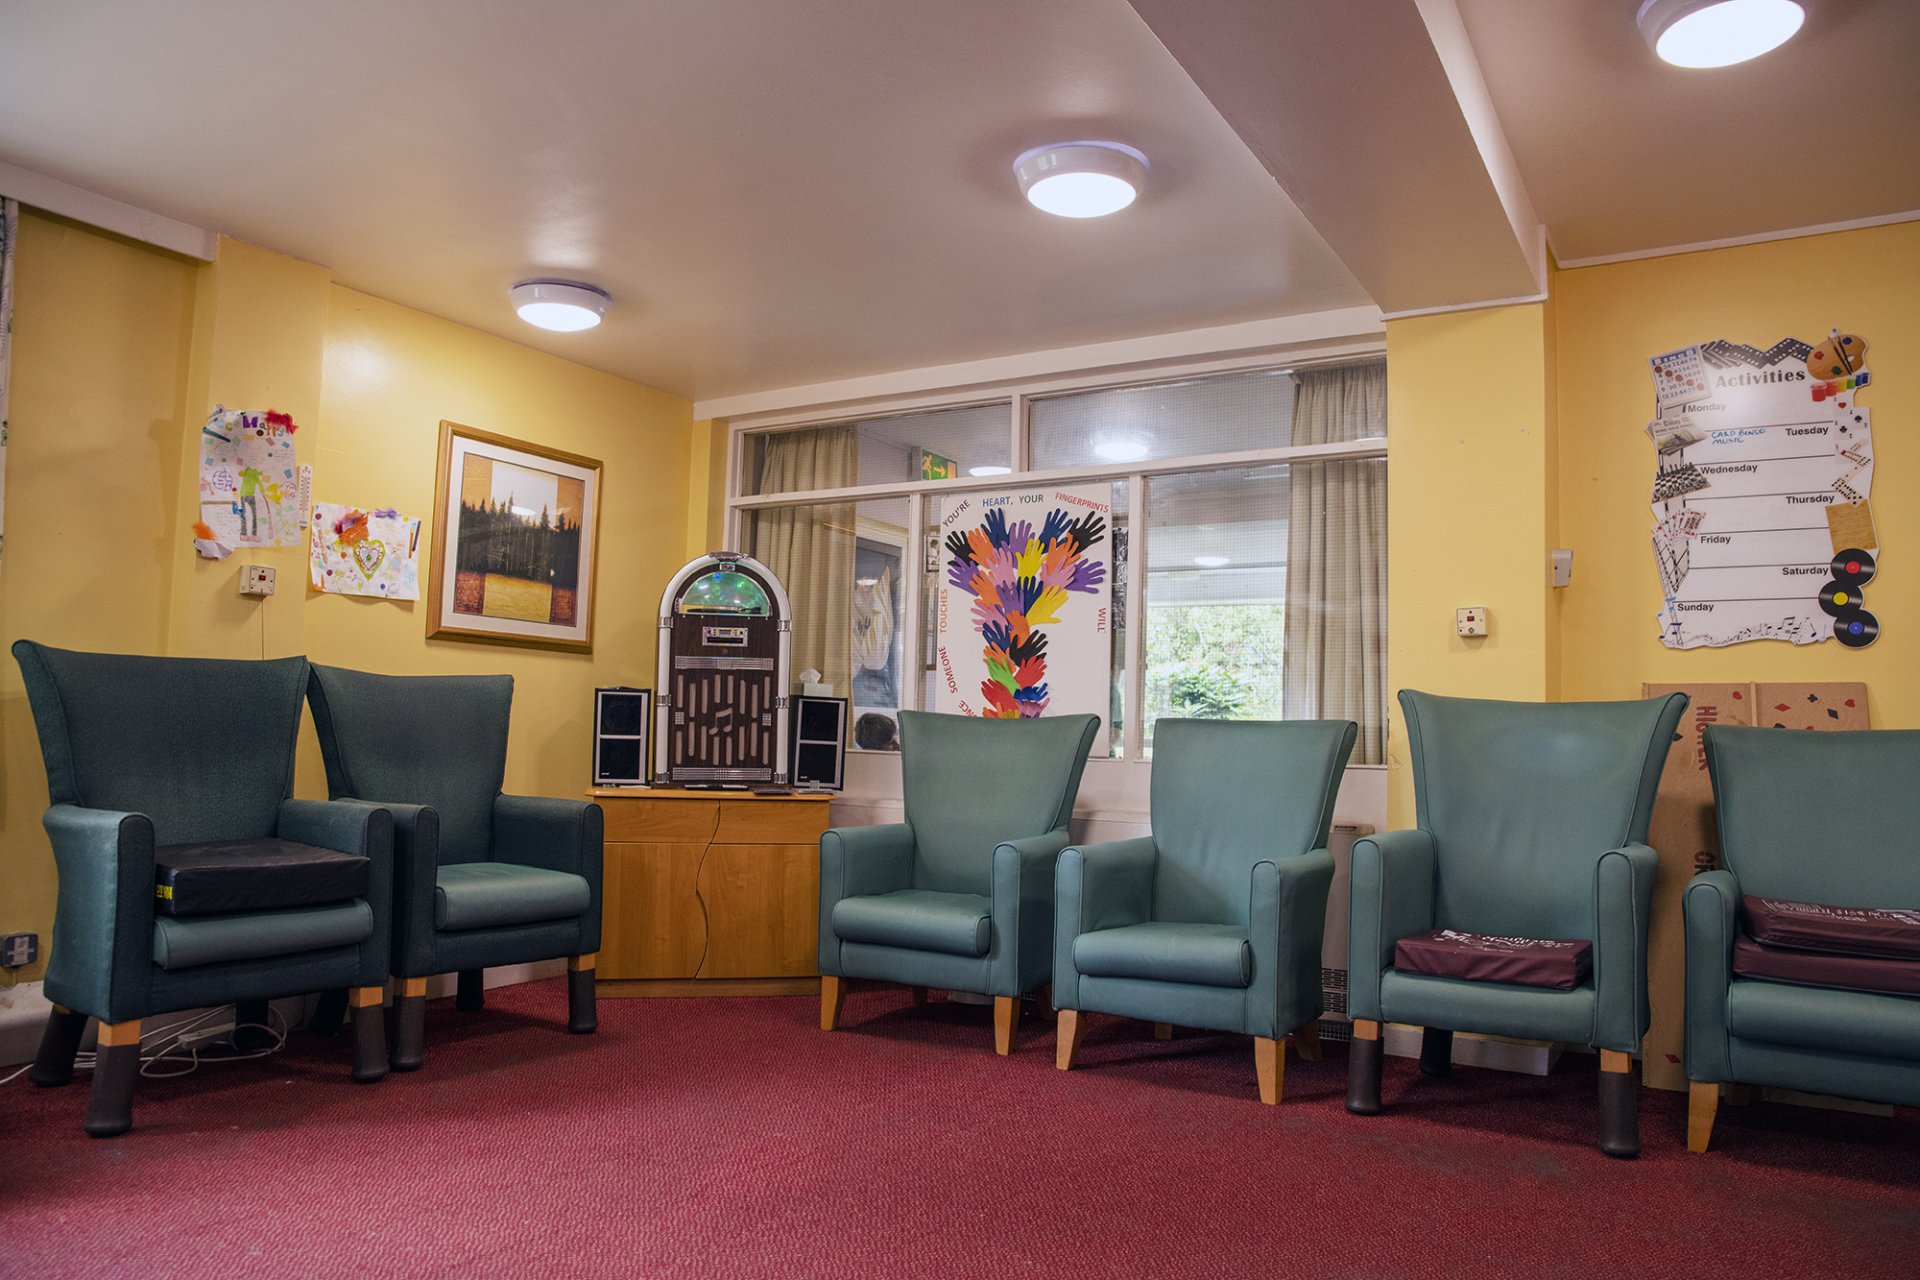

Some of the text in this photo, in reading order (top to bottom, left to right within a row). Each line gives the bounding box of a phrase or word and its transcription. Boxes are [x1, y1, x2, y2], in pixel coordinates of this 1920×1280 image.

[1716, 369, 1806, 388] Activities
[1687, 402, 1726, 412] Monday
[1785, 426, 1829, 436] Tuesday
[1712, 436, 1744, 445] MUSIC
[1700, 464, 1758, 474] Wednesday
[982, 495, 1013, 507] HEART,
[1018, 494, 1044, 504] YOUR
[1055, 492, 1110, 514] FINGERPRINTS
[1785, 494, 1835, 504] Thursday
[942, 499, 970, 528] YOU'RE
[1700, 535, 1731, 545] Friday
[1782, 566, 1829, 576] Saturday
[940, 588, 948, 634] TOUCHES
[1677, 603, 1714, 613] Sunday
[1097, 607, 1106, 633] WILL
[938, 645, 958, 694] SOMEONE
